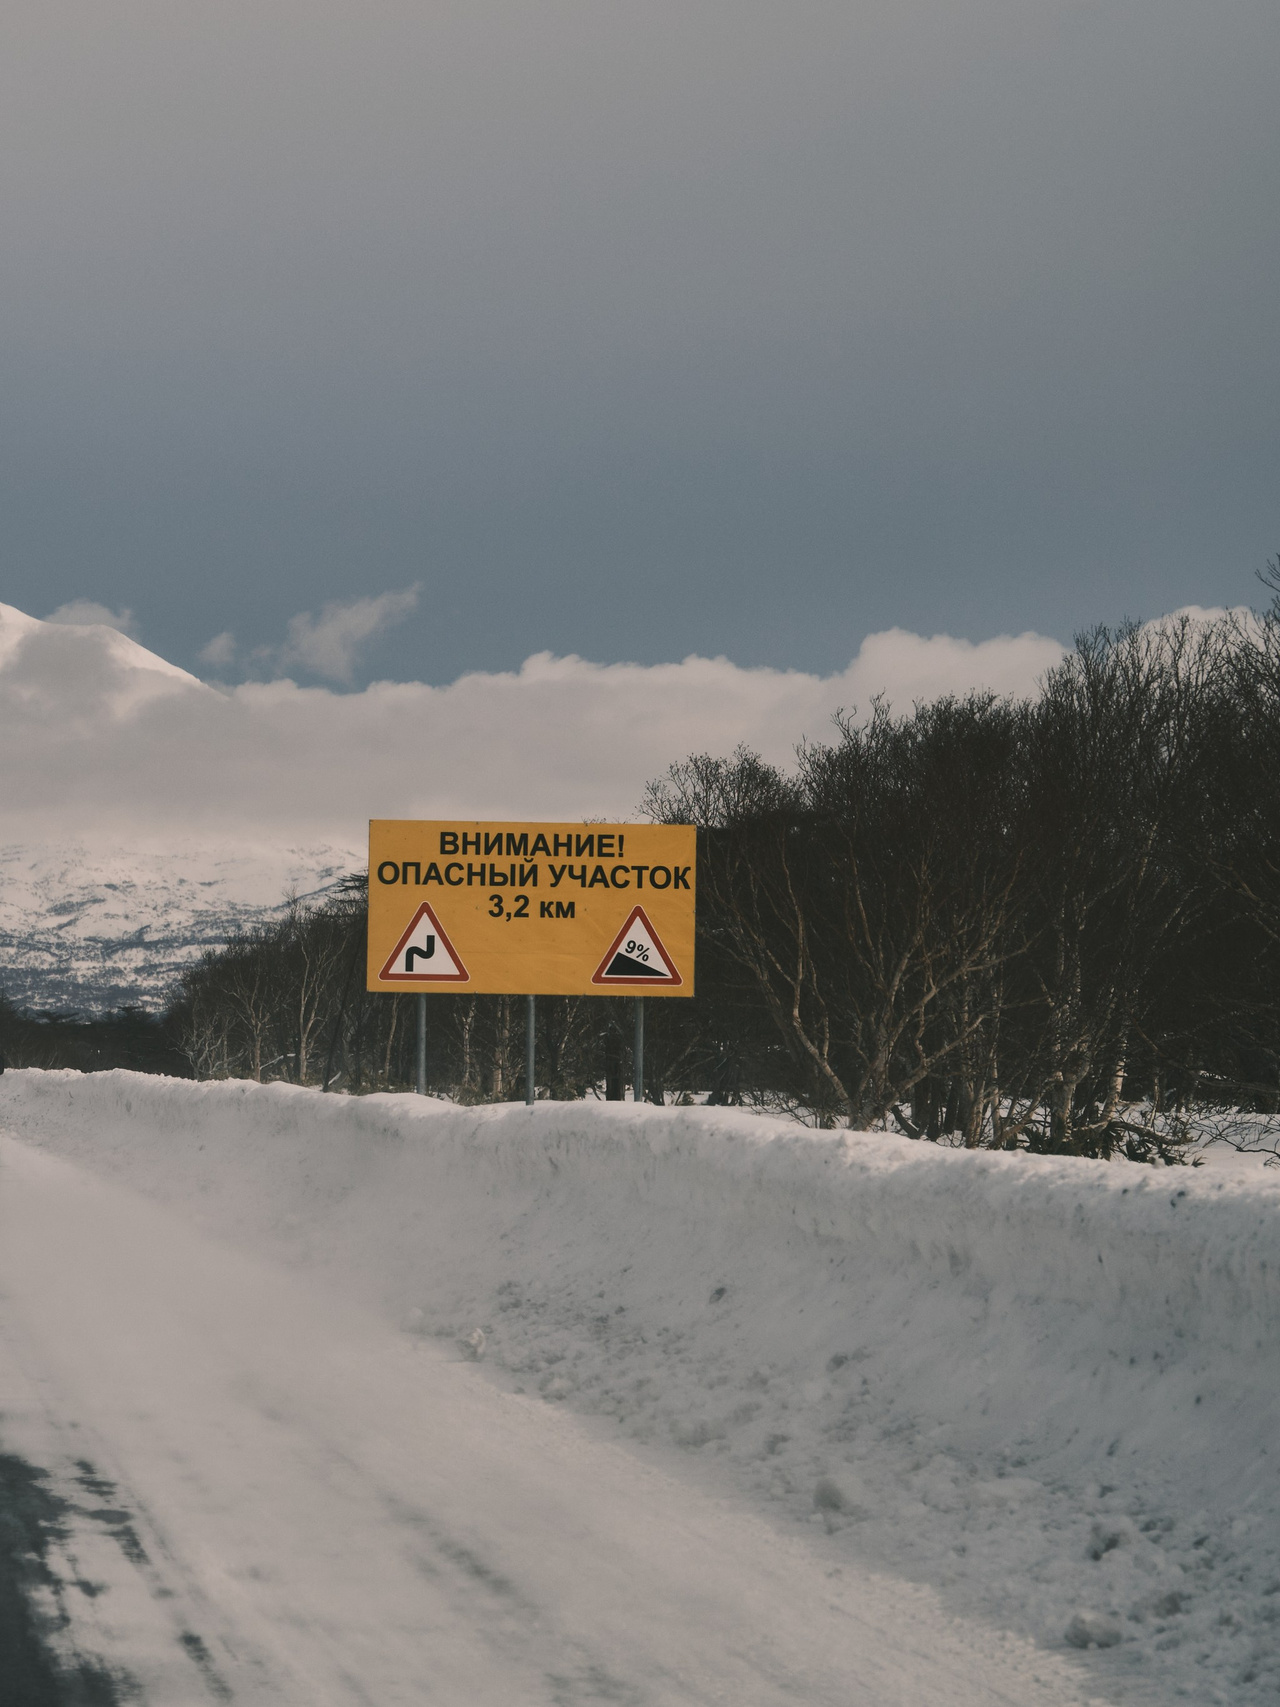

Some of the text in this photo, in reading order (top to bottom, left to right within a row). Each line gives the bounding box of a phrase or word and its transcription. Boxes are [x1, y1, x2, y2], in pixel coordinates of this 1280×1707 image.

[439, 831, 625, 858] ВНИМАНИЕ!
[377, 857, 692, 890] ОПАСНЫЙ УЧАСТОК
[488, 894, 576, 922] 3,2 км
[624, 939, 650, 963] 9%
